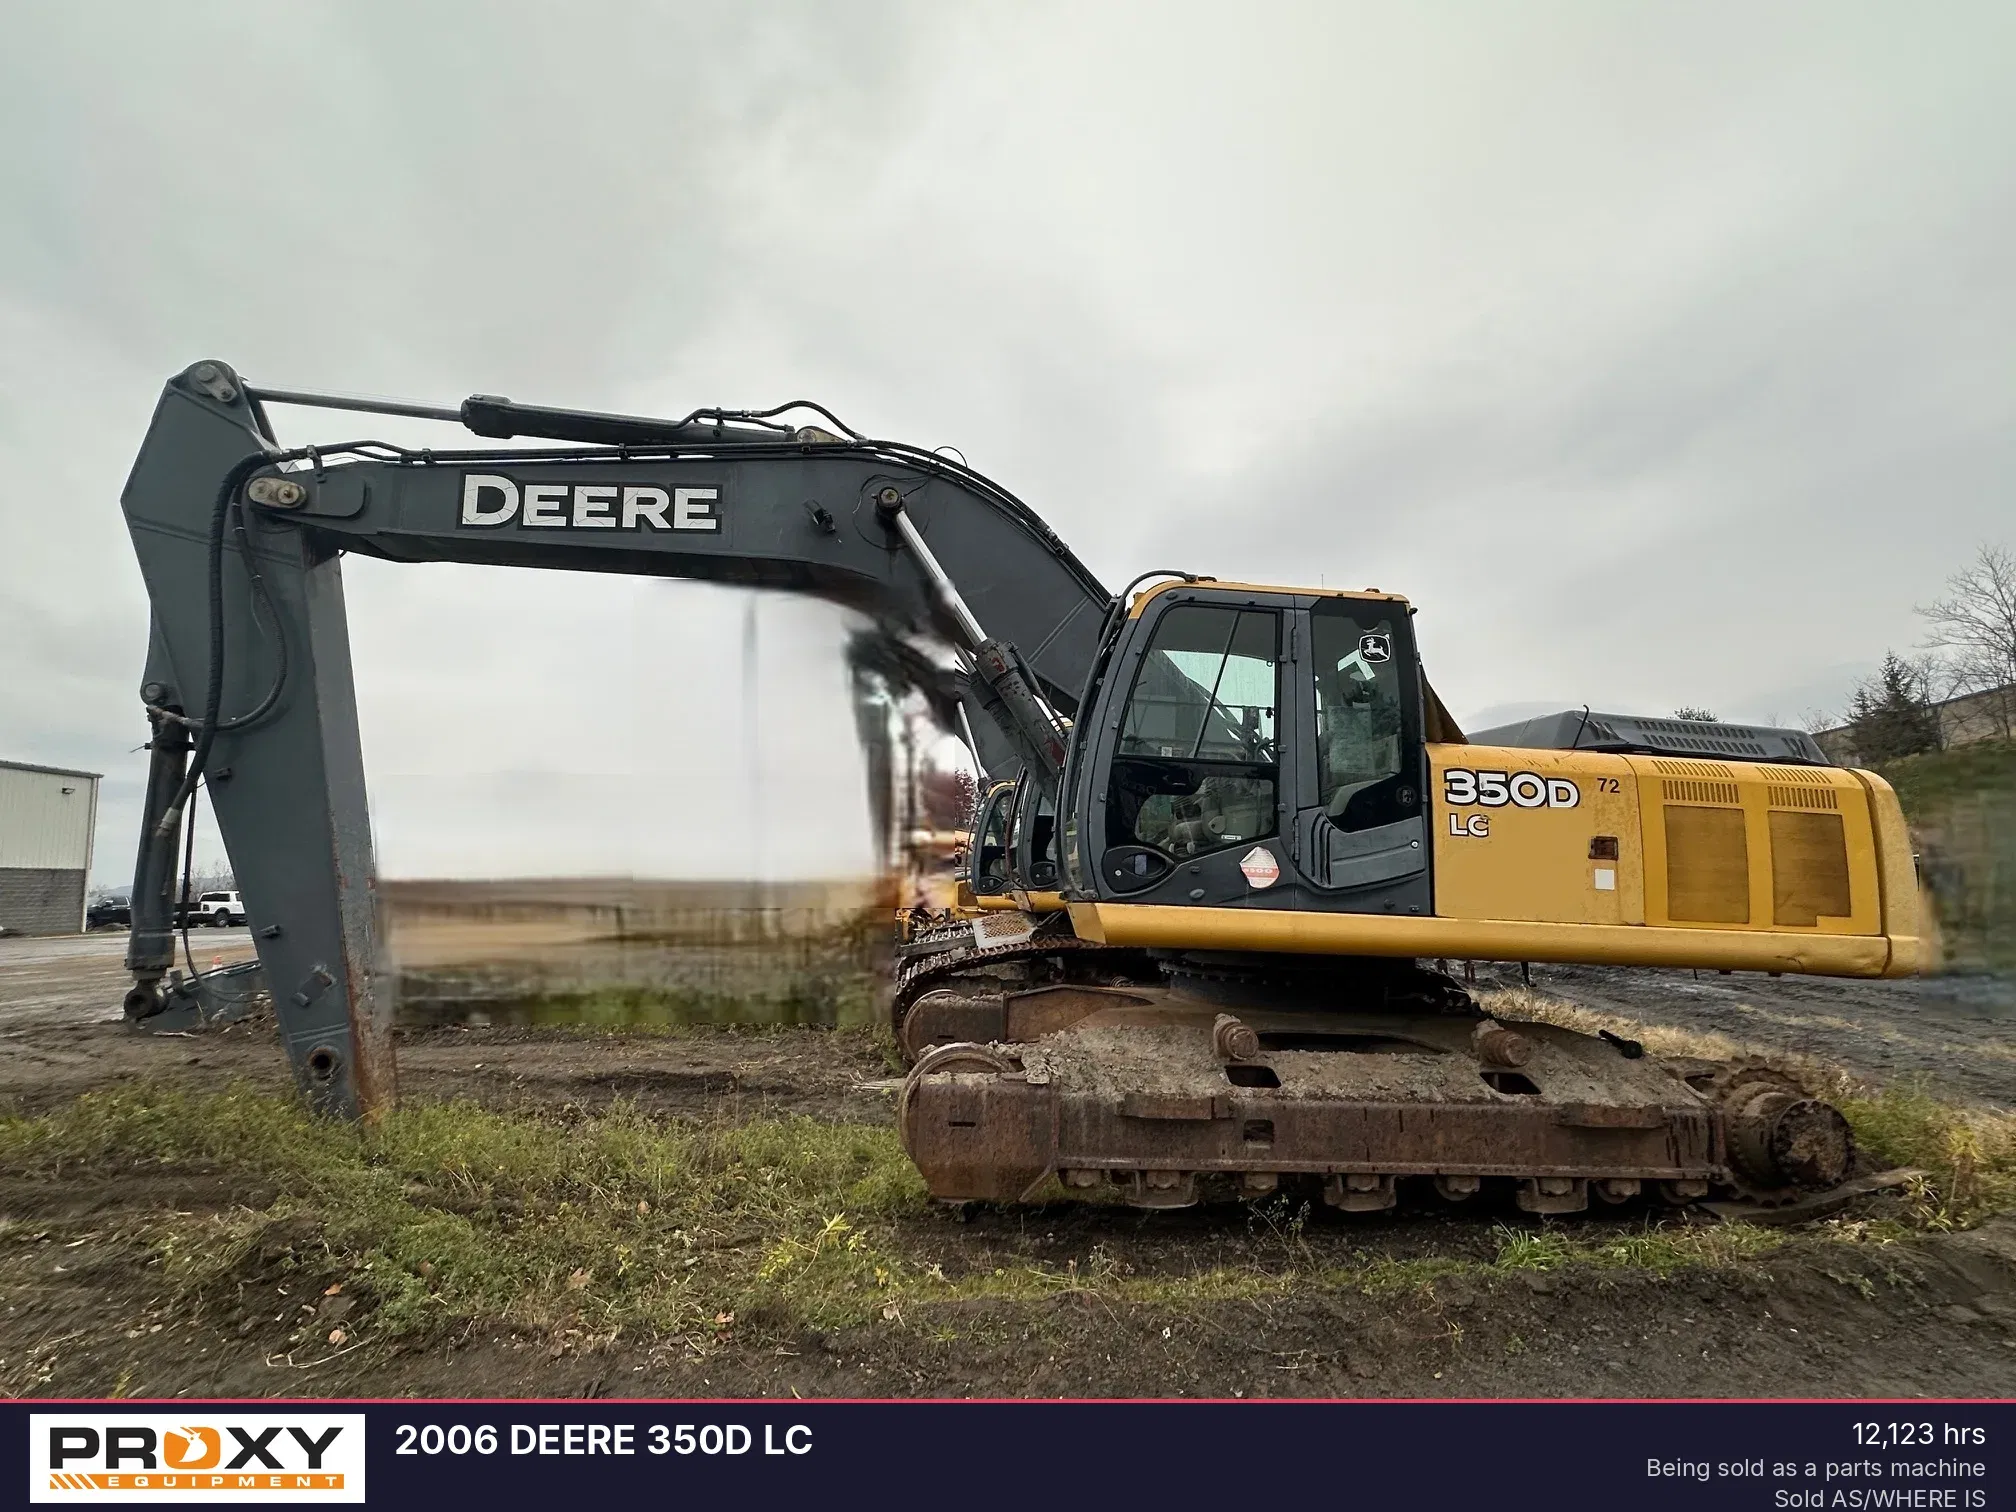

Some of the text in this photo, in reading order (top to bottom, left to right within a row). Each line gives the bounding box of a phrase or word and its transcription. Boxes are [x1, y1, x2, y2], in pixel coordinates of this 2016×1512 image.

[461, 473, 718, 530] DEERE
[1444, 768, 1580, 807] 350D
[1596, 777, 1621, 794] 72
[1449, 813, 1490, 837] LC
